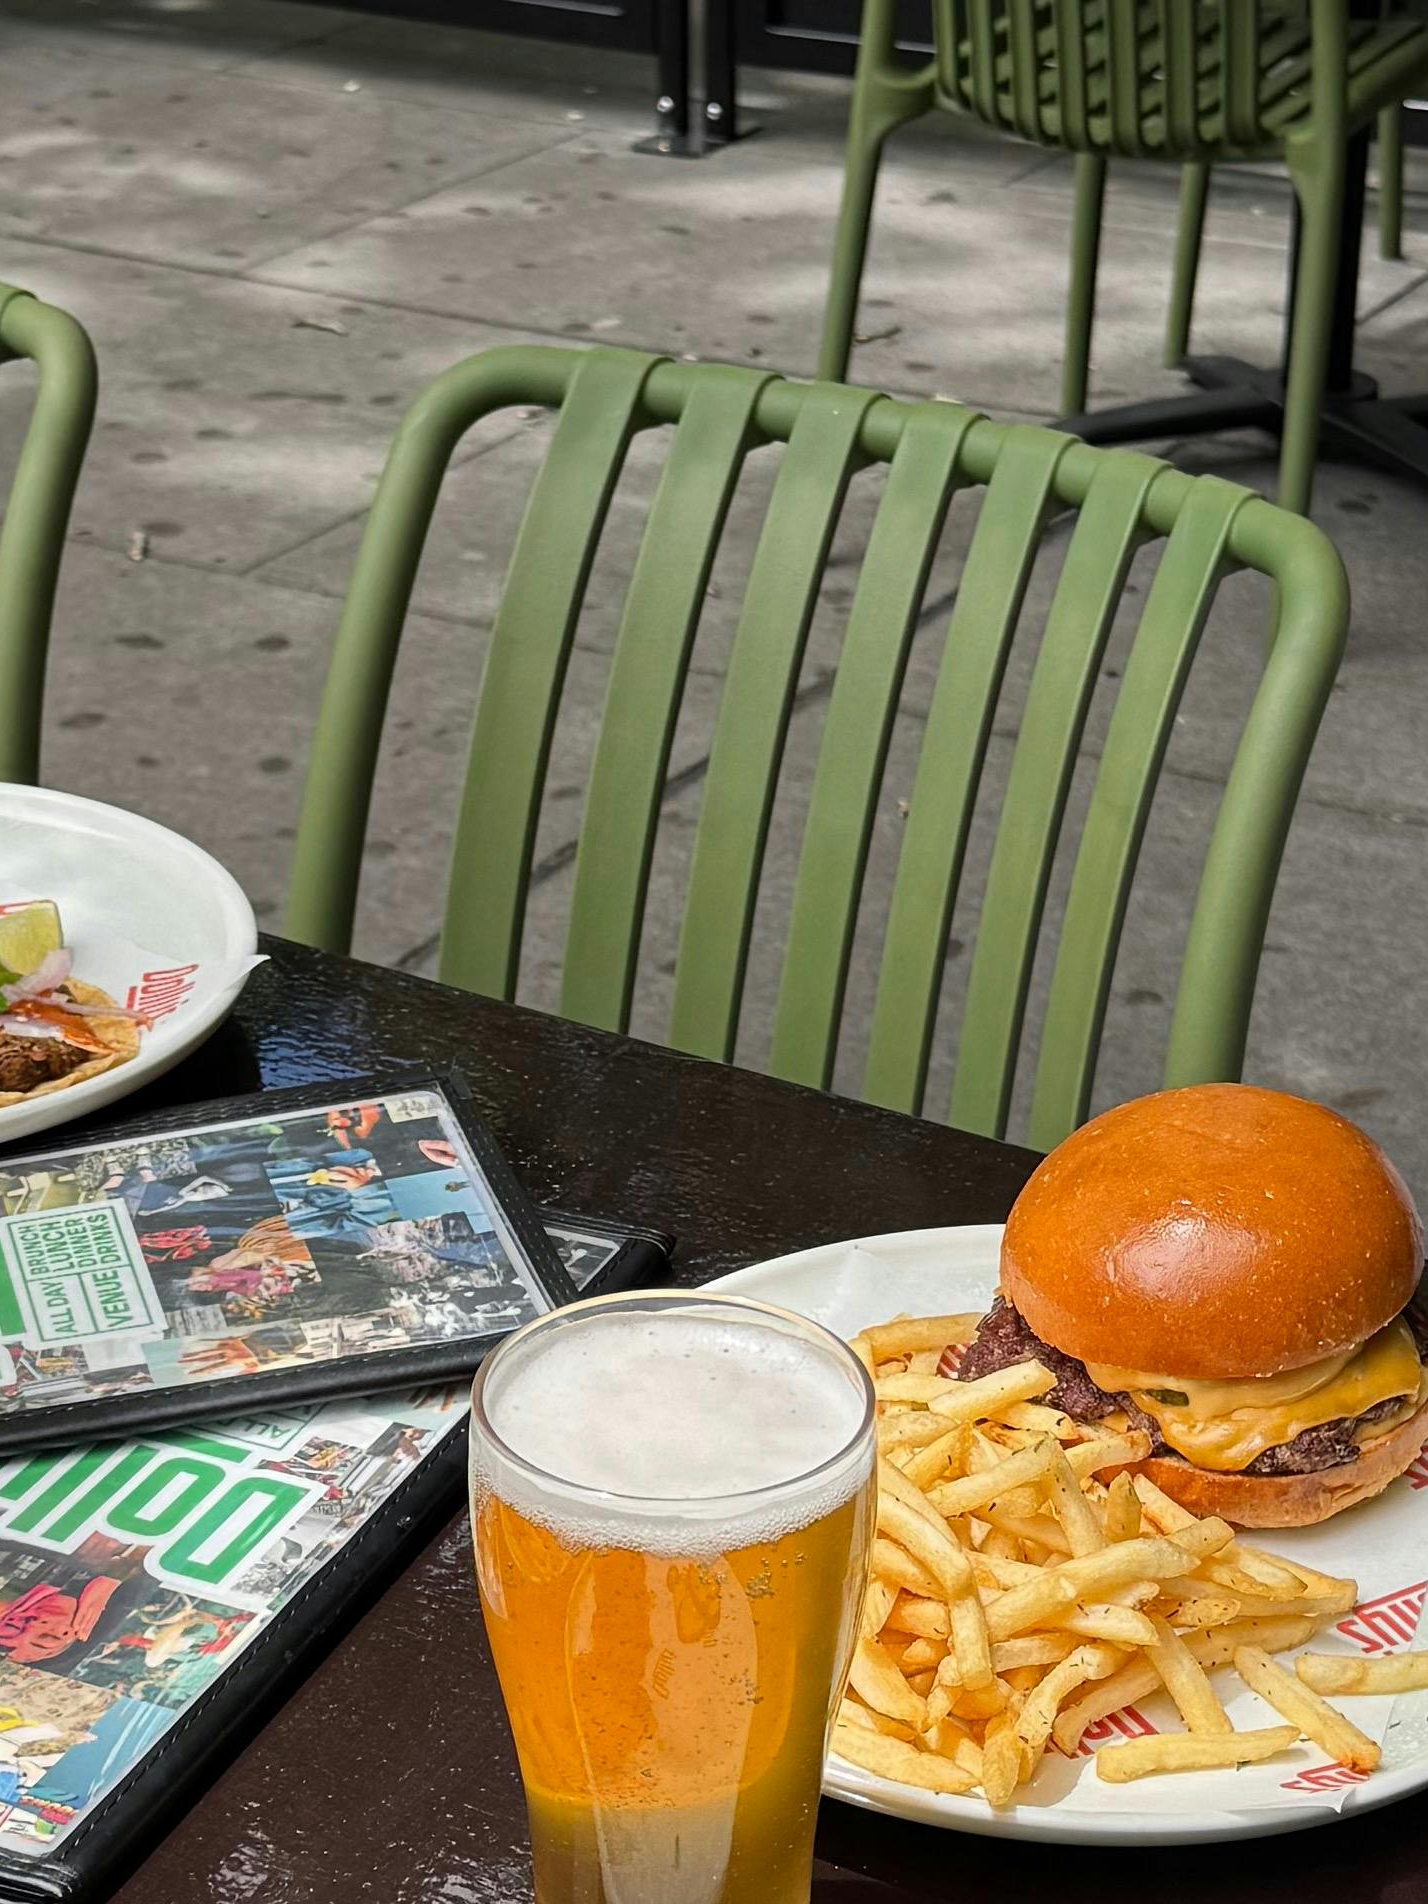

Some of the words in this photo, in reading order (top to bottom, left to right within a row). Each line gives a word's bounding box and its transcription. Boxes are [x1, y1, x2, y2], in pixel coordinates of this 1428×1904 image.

[17, 1224, 49, 1275] BRUNCH
[38, 1220, 75, 1273] LUNCH
[64, 1217, 98, 1268] DINNER
[87, 1213, 122, 1264] DRINKS
[41, 1281, 70, 1308] DAY
[91, 1269, 134, 1328] VENUE
[50, 1309, 78, 1333] ALL
